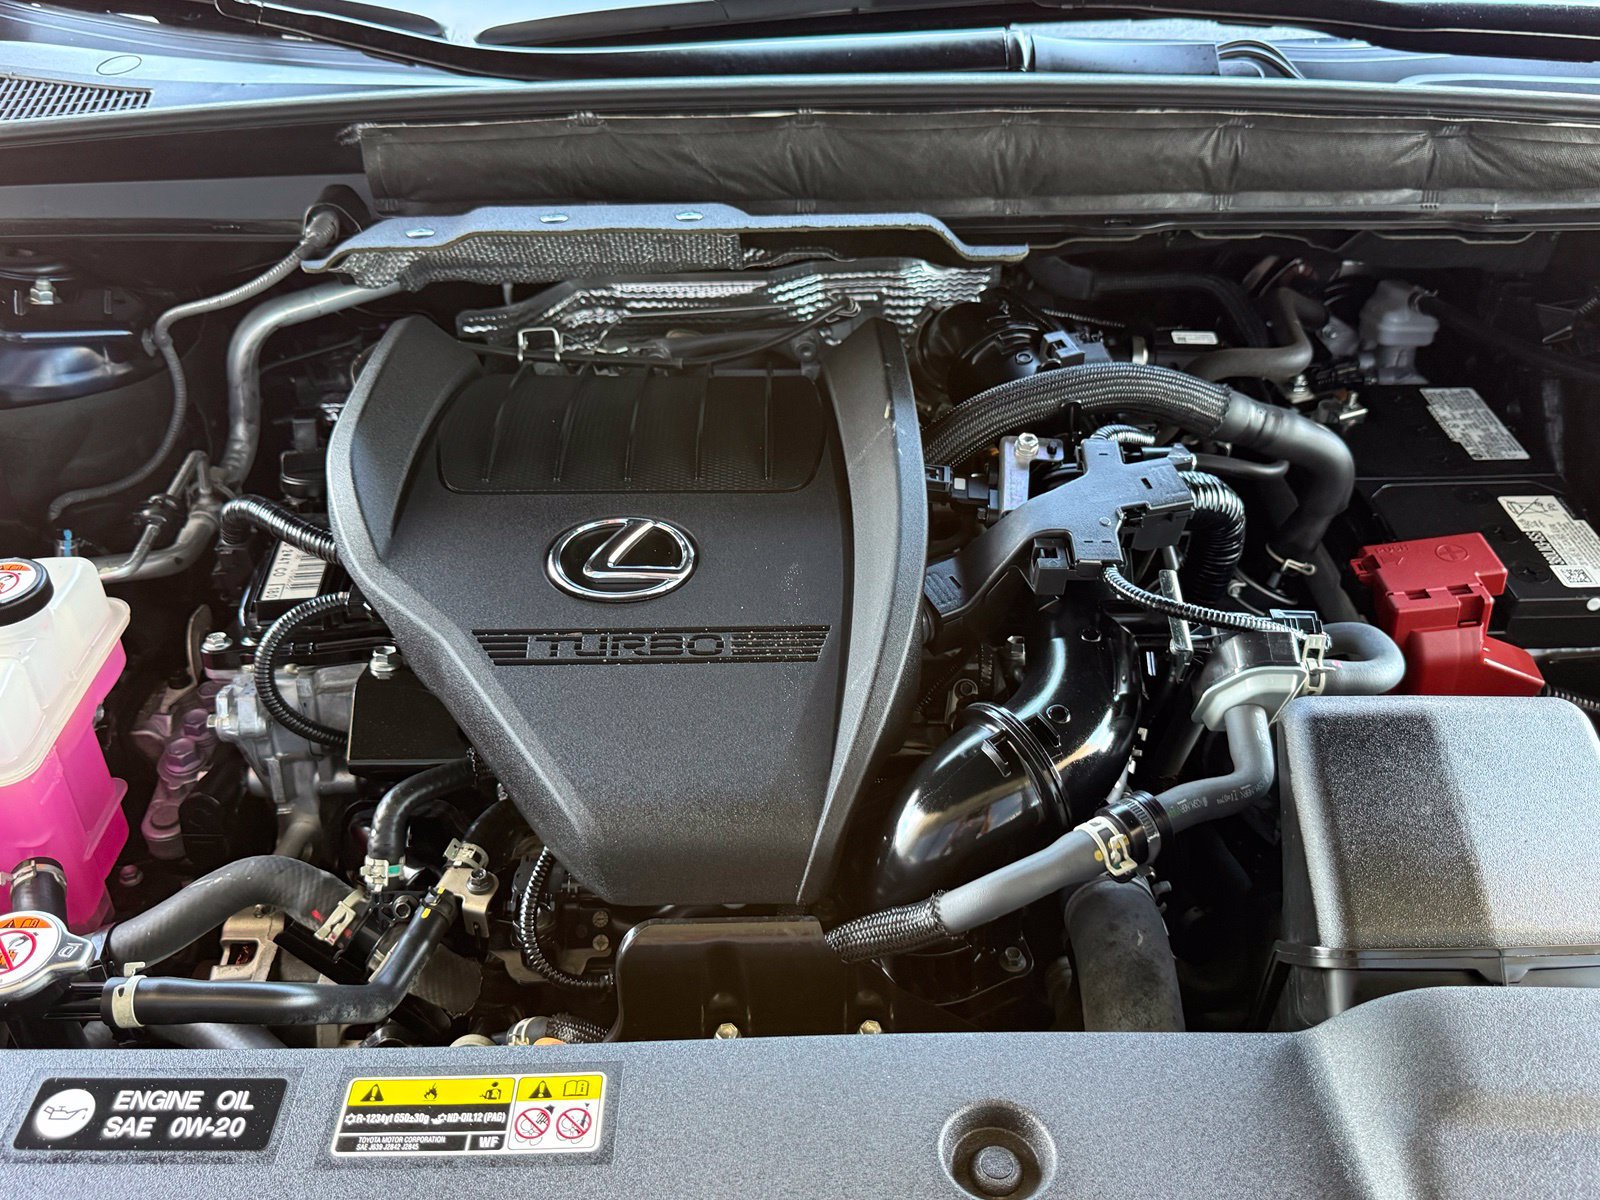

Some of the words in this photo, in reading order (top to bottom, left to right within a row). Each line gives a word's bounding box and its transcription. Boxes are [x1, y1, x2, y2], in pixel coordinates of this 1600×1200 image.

[533, 633, 725, 657] TURBO
[113, 1090, 205, 1111] ENGINE
[216, 1090, 255, 1111] OIL
[356, 1113, 393, 1126] R-1234yf
[394, 1112, 430, 1125] 650±30g
[483, 1111, 507, 1124] (PAG)
[103, 1116, 156, 1138] SAE
[170, 1116, 247, 1138] 0W-20
[356, 1143, 368, 1151] SAE
[368, 1143, 384, 1151] J639
[358, 1136, 382, 1144] TOYOTA
[381, 1136, 404, 1144] MOTOR
[404, 1135, 447, 1144] CORPORATION
[479, 1136, 500, 1149] WF
